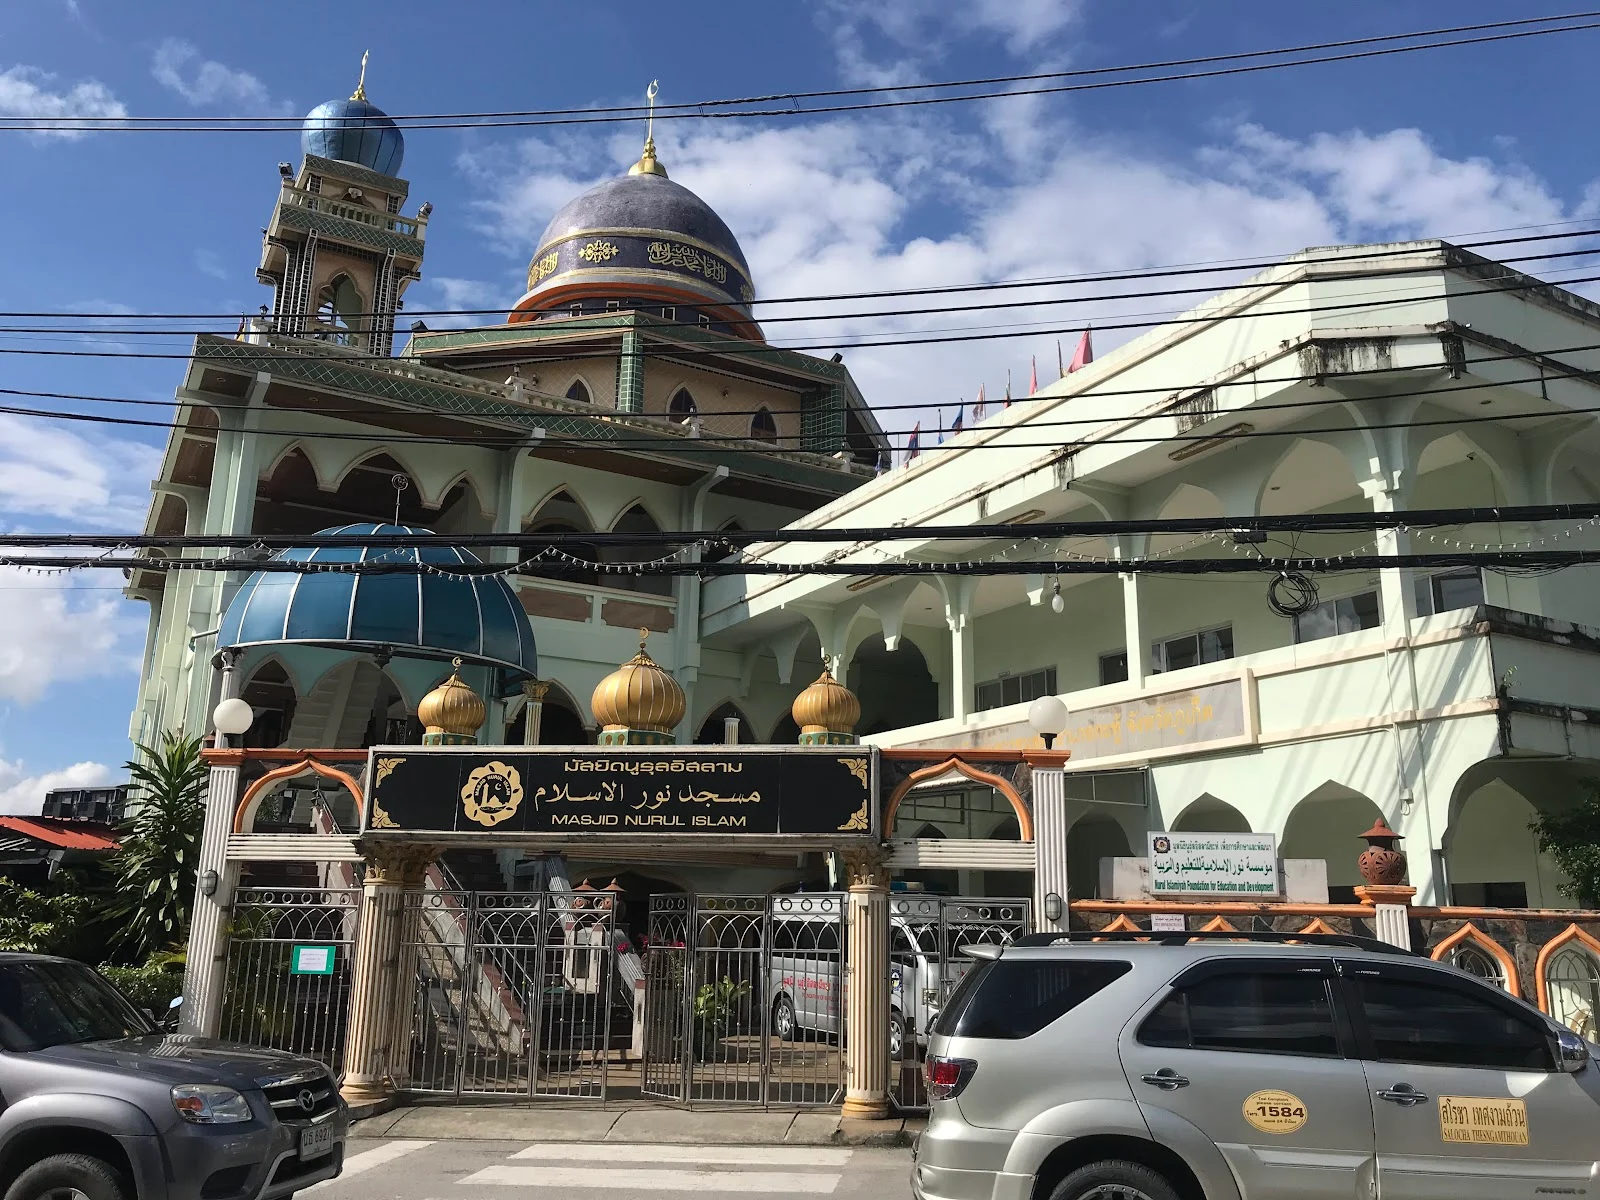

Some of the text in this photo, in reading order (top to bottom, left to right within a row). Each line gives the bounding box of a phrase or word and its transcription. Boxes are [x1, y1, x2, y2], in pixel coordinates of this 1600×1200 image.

[630, 784, 672, 810] نور
[679, 784, 761, 808] مسجد
[551, 814, 747, 828] MASJID NURUL ISLAM
[1231, 858, 1244, 876] نور
[1154, 880, 1166, 890] Nurul
[1187, 881, 1210, 891] Foundation
[1217, 881, 1237, 892] Education
[1238, 882, 1246, 892] and
[1246, 882, 1274, 894] Development
[1257, 1106, 1305, 1118] 1584
[1441, 1098, 1470, 1125] สโรชา
[1443, 1128, 1471, 1141] SALOCHA
